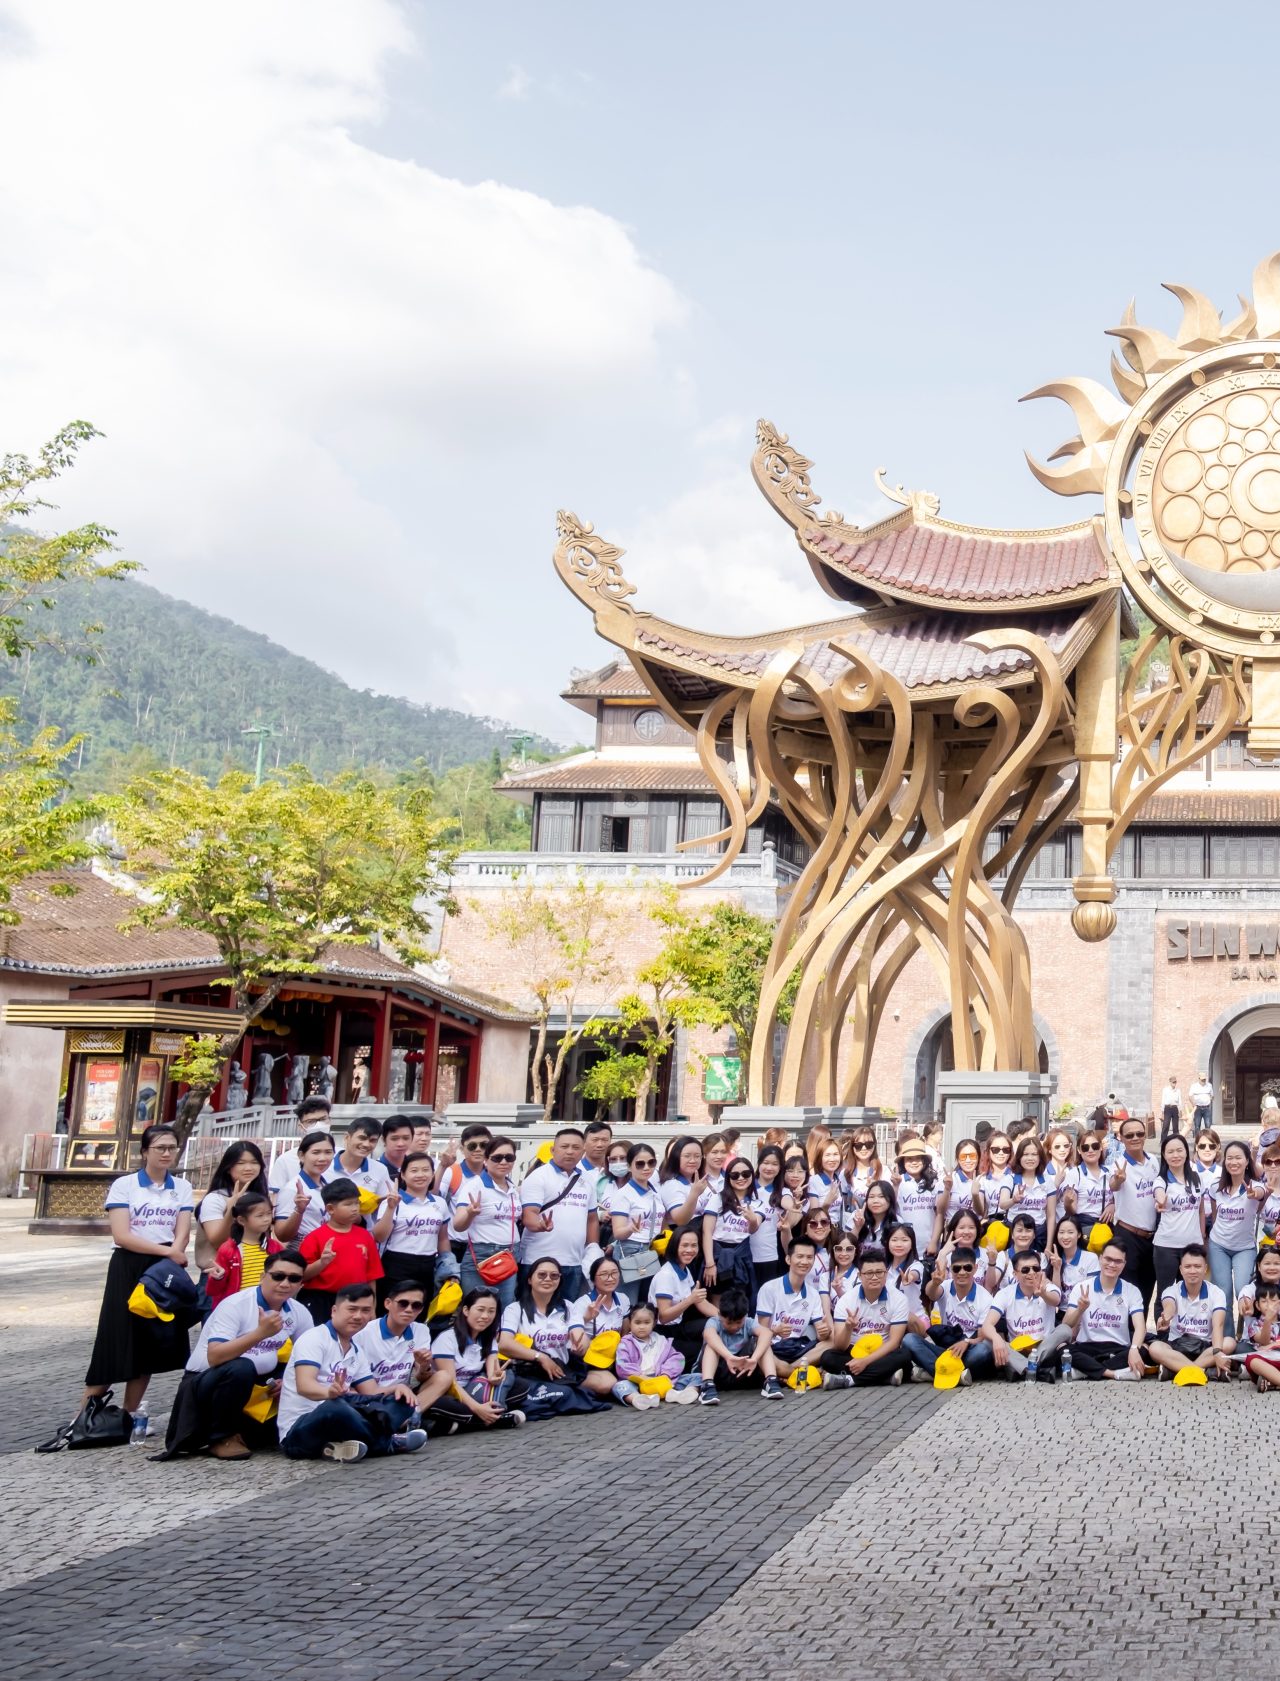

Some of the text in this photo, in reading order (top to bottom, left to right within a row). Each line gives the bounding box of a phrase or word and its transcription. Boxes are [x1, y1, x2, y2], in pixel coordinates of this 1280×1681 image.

[1167, 919, 1240, 960] SUN
[1231, 966, 1250, 980] BA
[406, 1215, 441, 1228] Viptee
[1089, 1308, 1121, 1321] Vipteen
[1178, 1312, 1208, 1326] Vipteen
